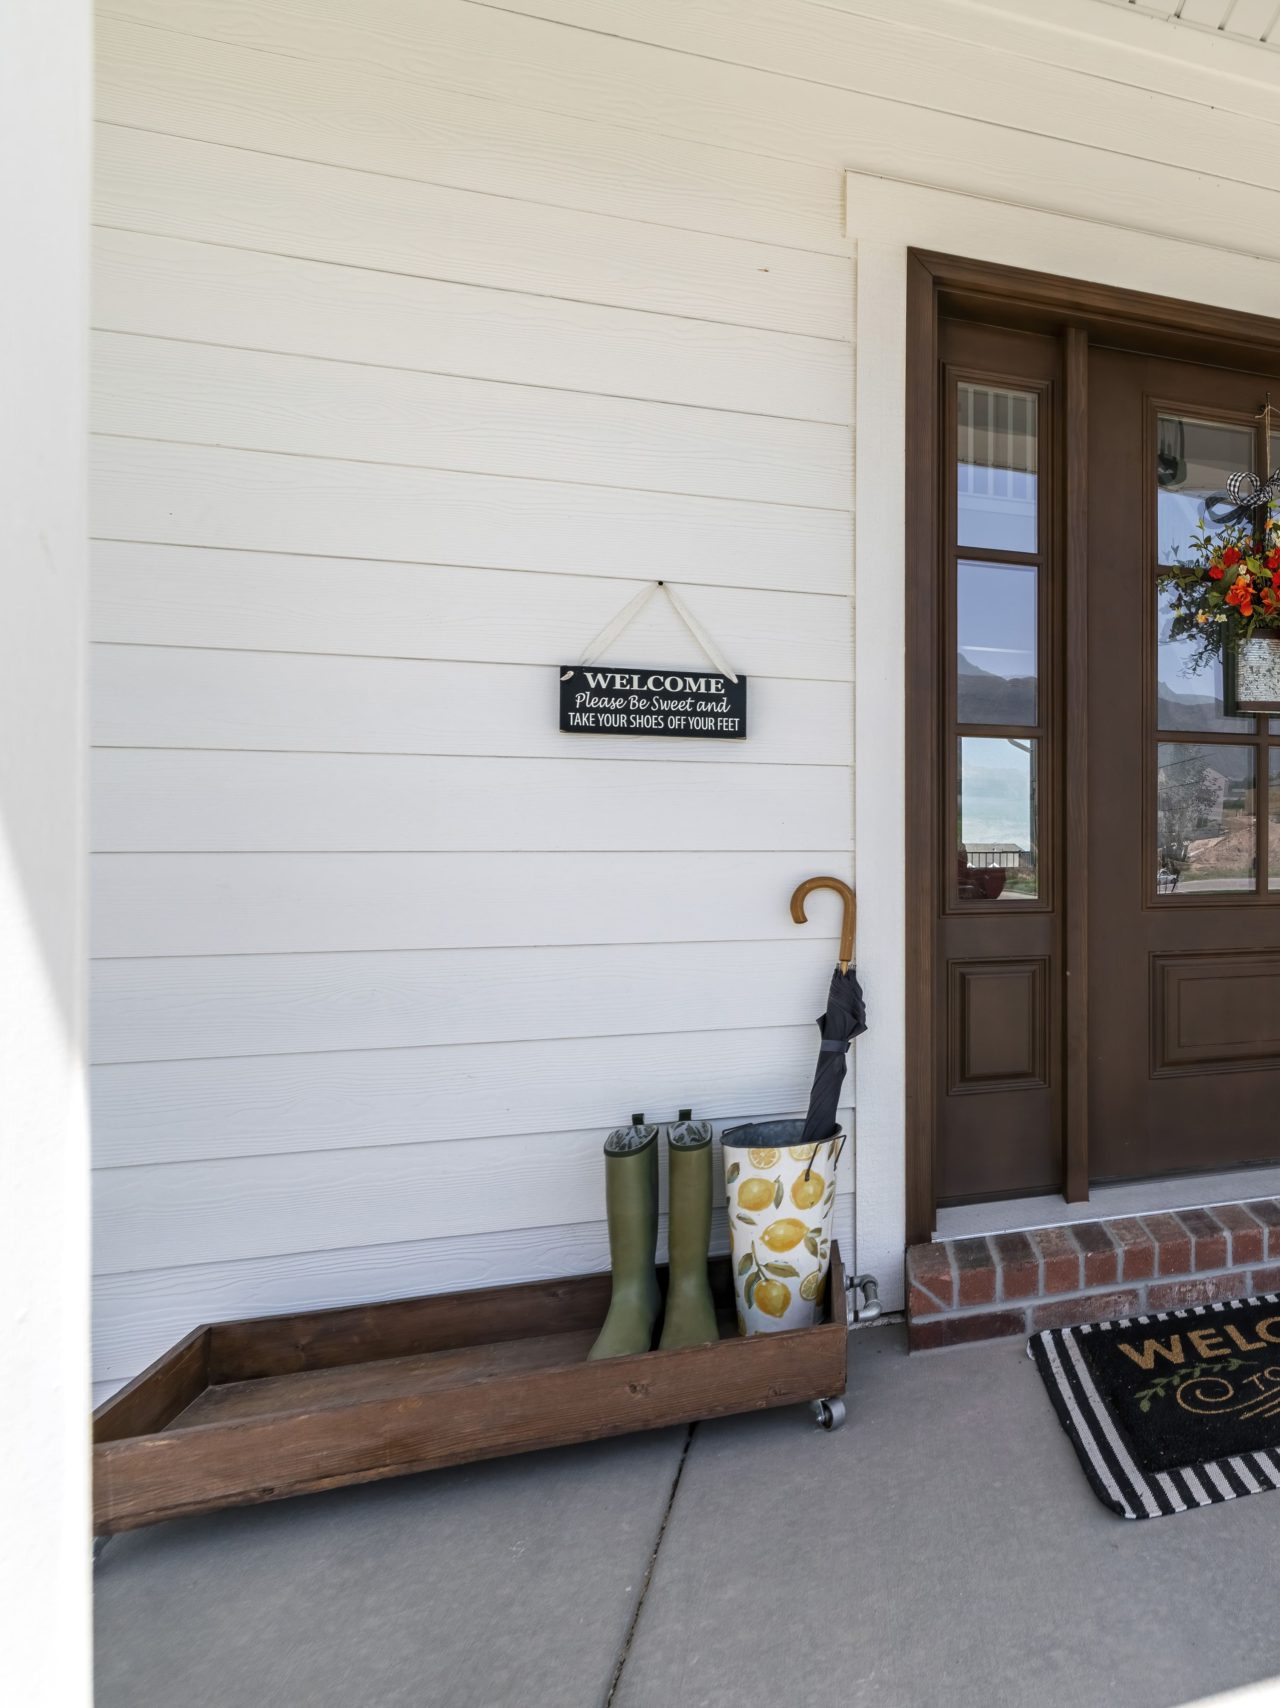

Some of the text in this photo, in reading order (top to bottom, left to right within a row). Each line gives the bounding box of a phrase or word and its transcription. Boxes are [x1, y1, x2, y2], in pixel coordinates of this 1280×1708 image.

[583, 672, 725, 694] WELCOME
[575, 692, 731, 713] Please Be Sweet and
[568, 712, 740, 731] TAKE YOUR SHOES OFF YOUR FEET
